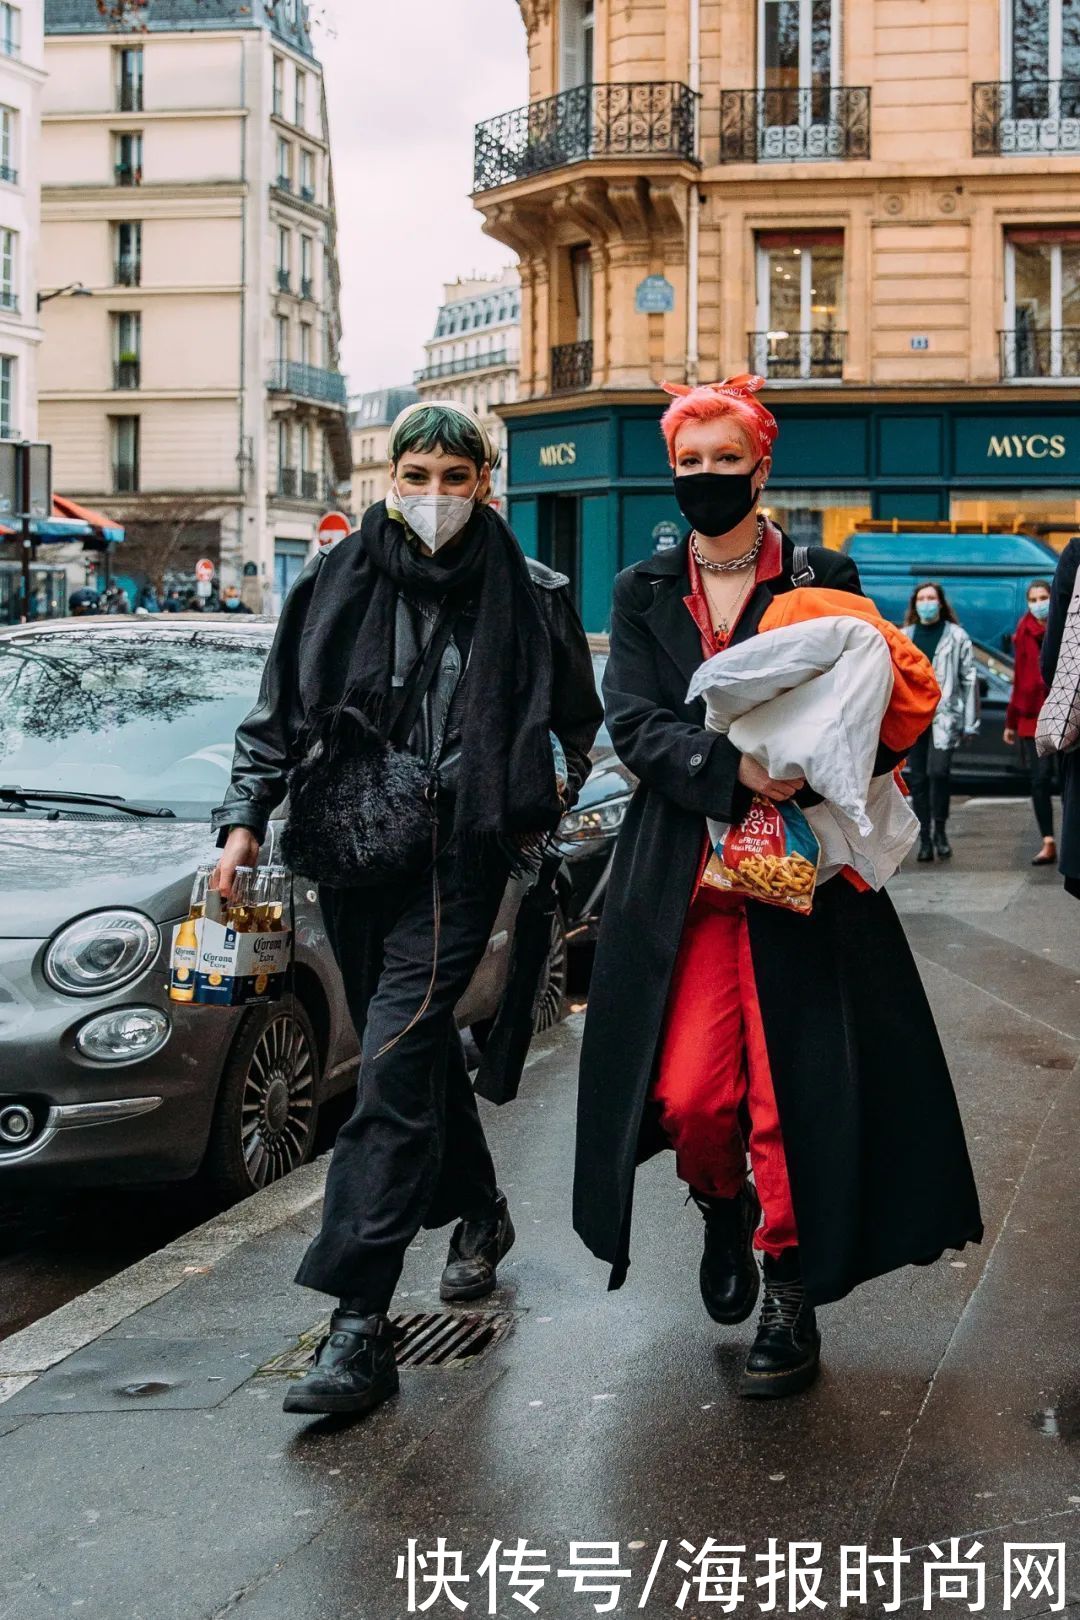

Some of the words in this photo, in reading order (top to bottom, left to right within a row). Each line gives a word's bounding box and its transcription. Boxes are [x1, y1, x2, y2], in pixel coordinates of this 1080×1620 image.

[539, 442, 576, 466] MYCS
[987, 434, 1066, 458] MYCS
[227, 934, 234, 942] 6
[203, 953, 233, 963] Corona
